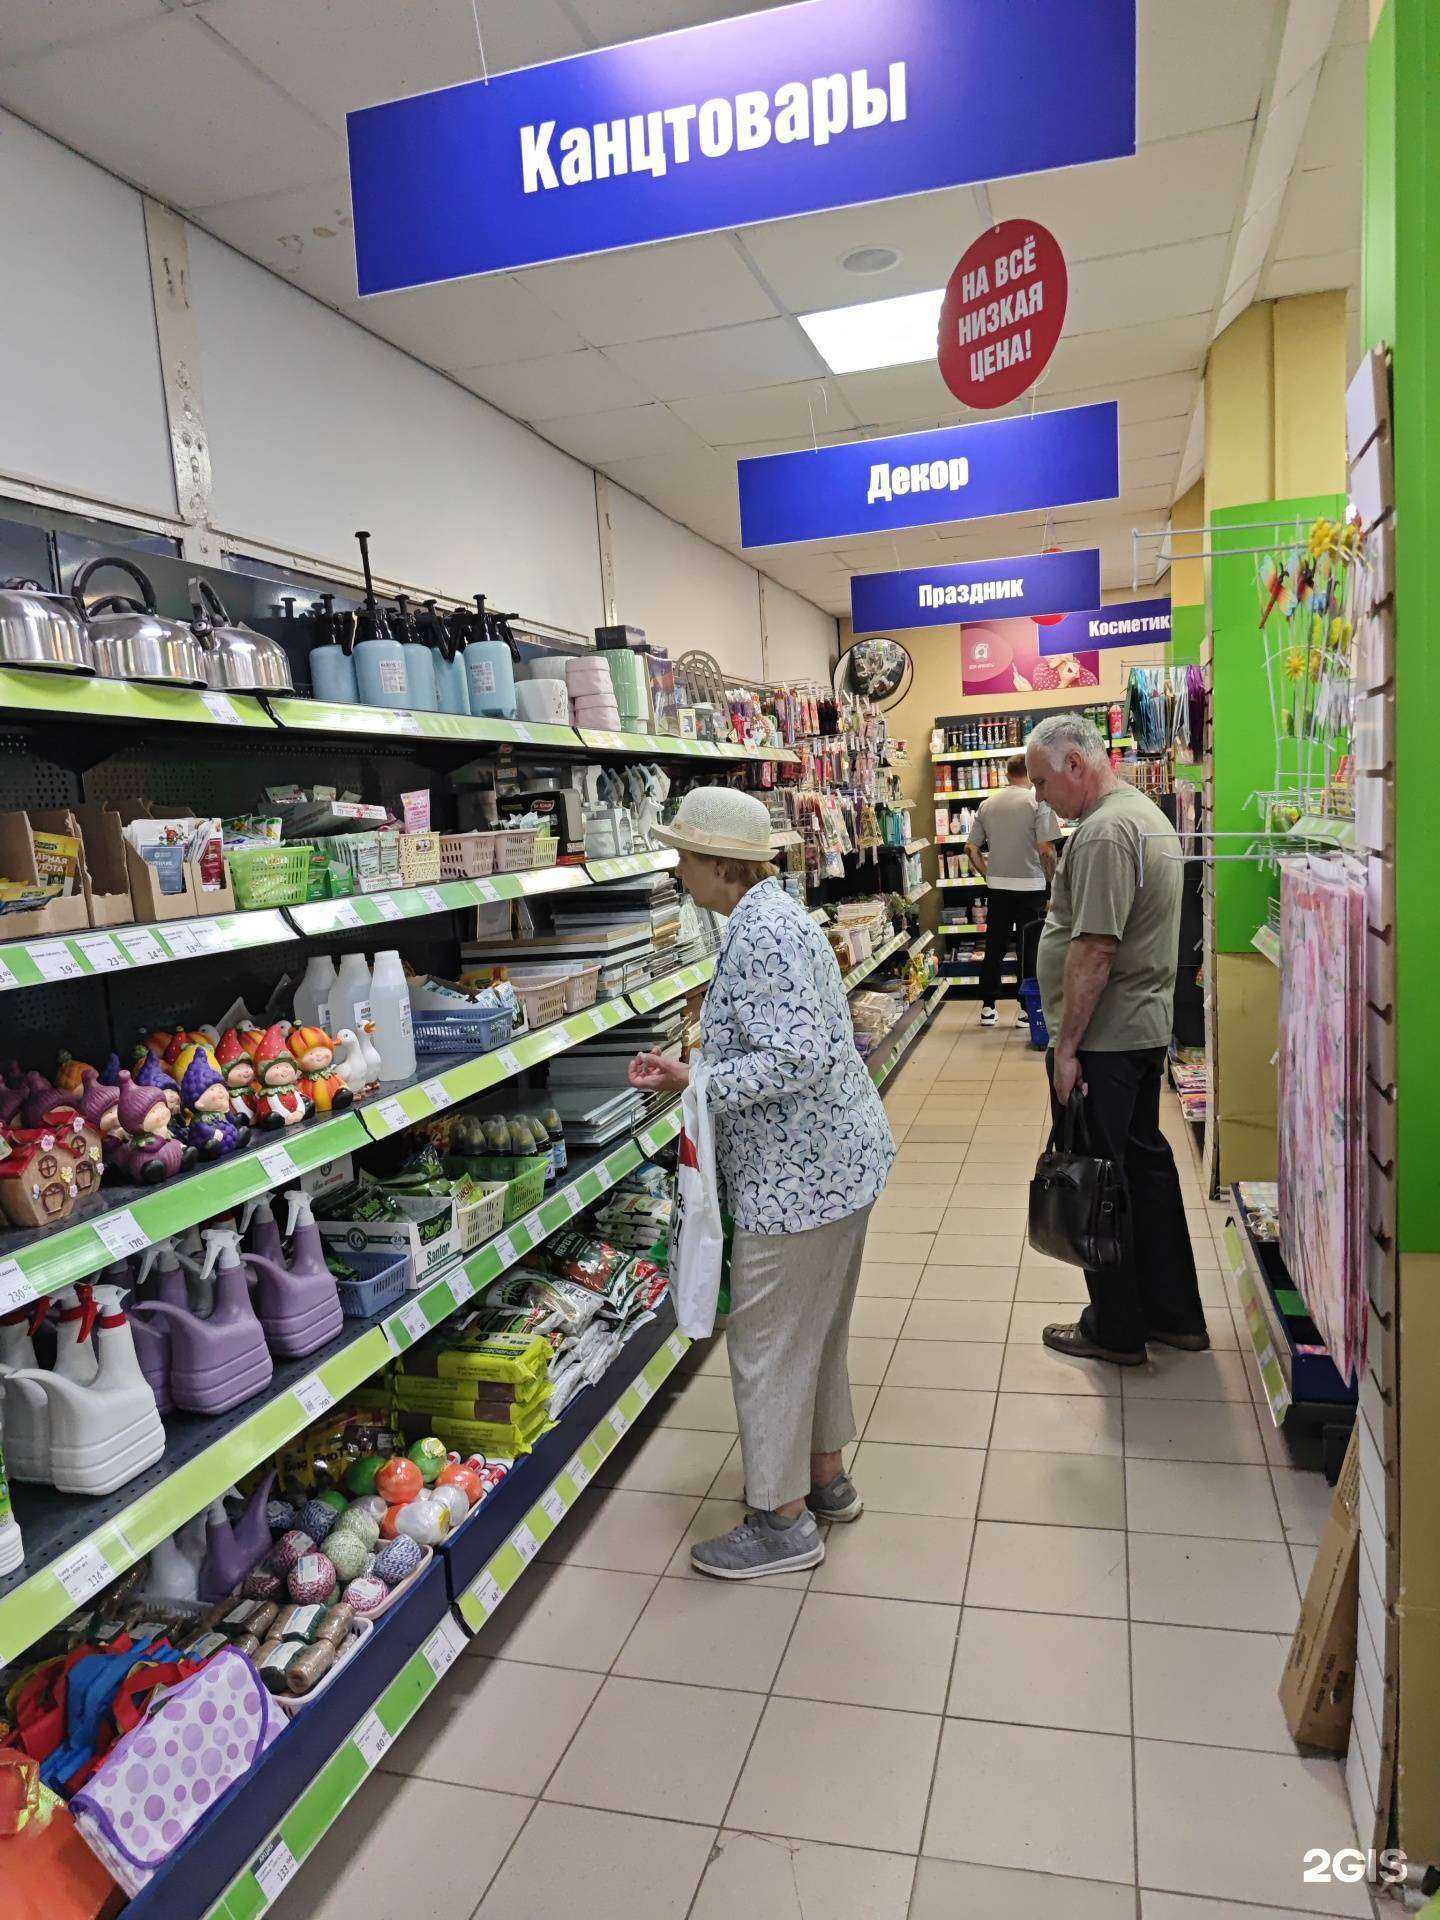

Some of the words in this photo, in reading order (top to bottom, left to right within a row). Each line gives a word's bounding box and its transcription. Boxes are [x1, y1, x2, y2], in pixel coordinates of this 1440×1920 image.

[521, 62, 908, 194] Канцтовары
[961, 269, 992, 302] НА
[994, 234, 1038, 290] ВСЁ
[957, 281, 1045, 347] НИЗКАЯ
[969, 332, 1034, 385] ЦЕНА!
[867, 456, 970, 504] Декор
[918, 577, 1024, 608] Праздник
[1089, 614, 1172, 637] Косметик
